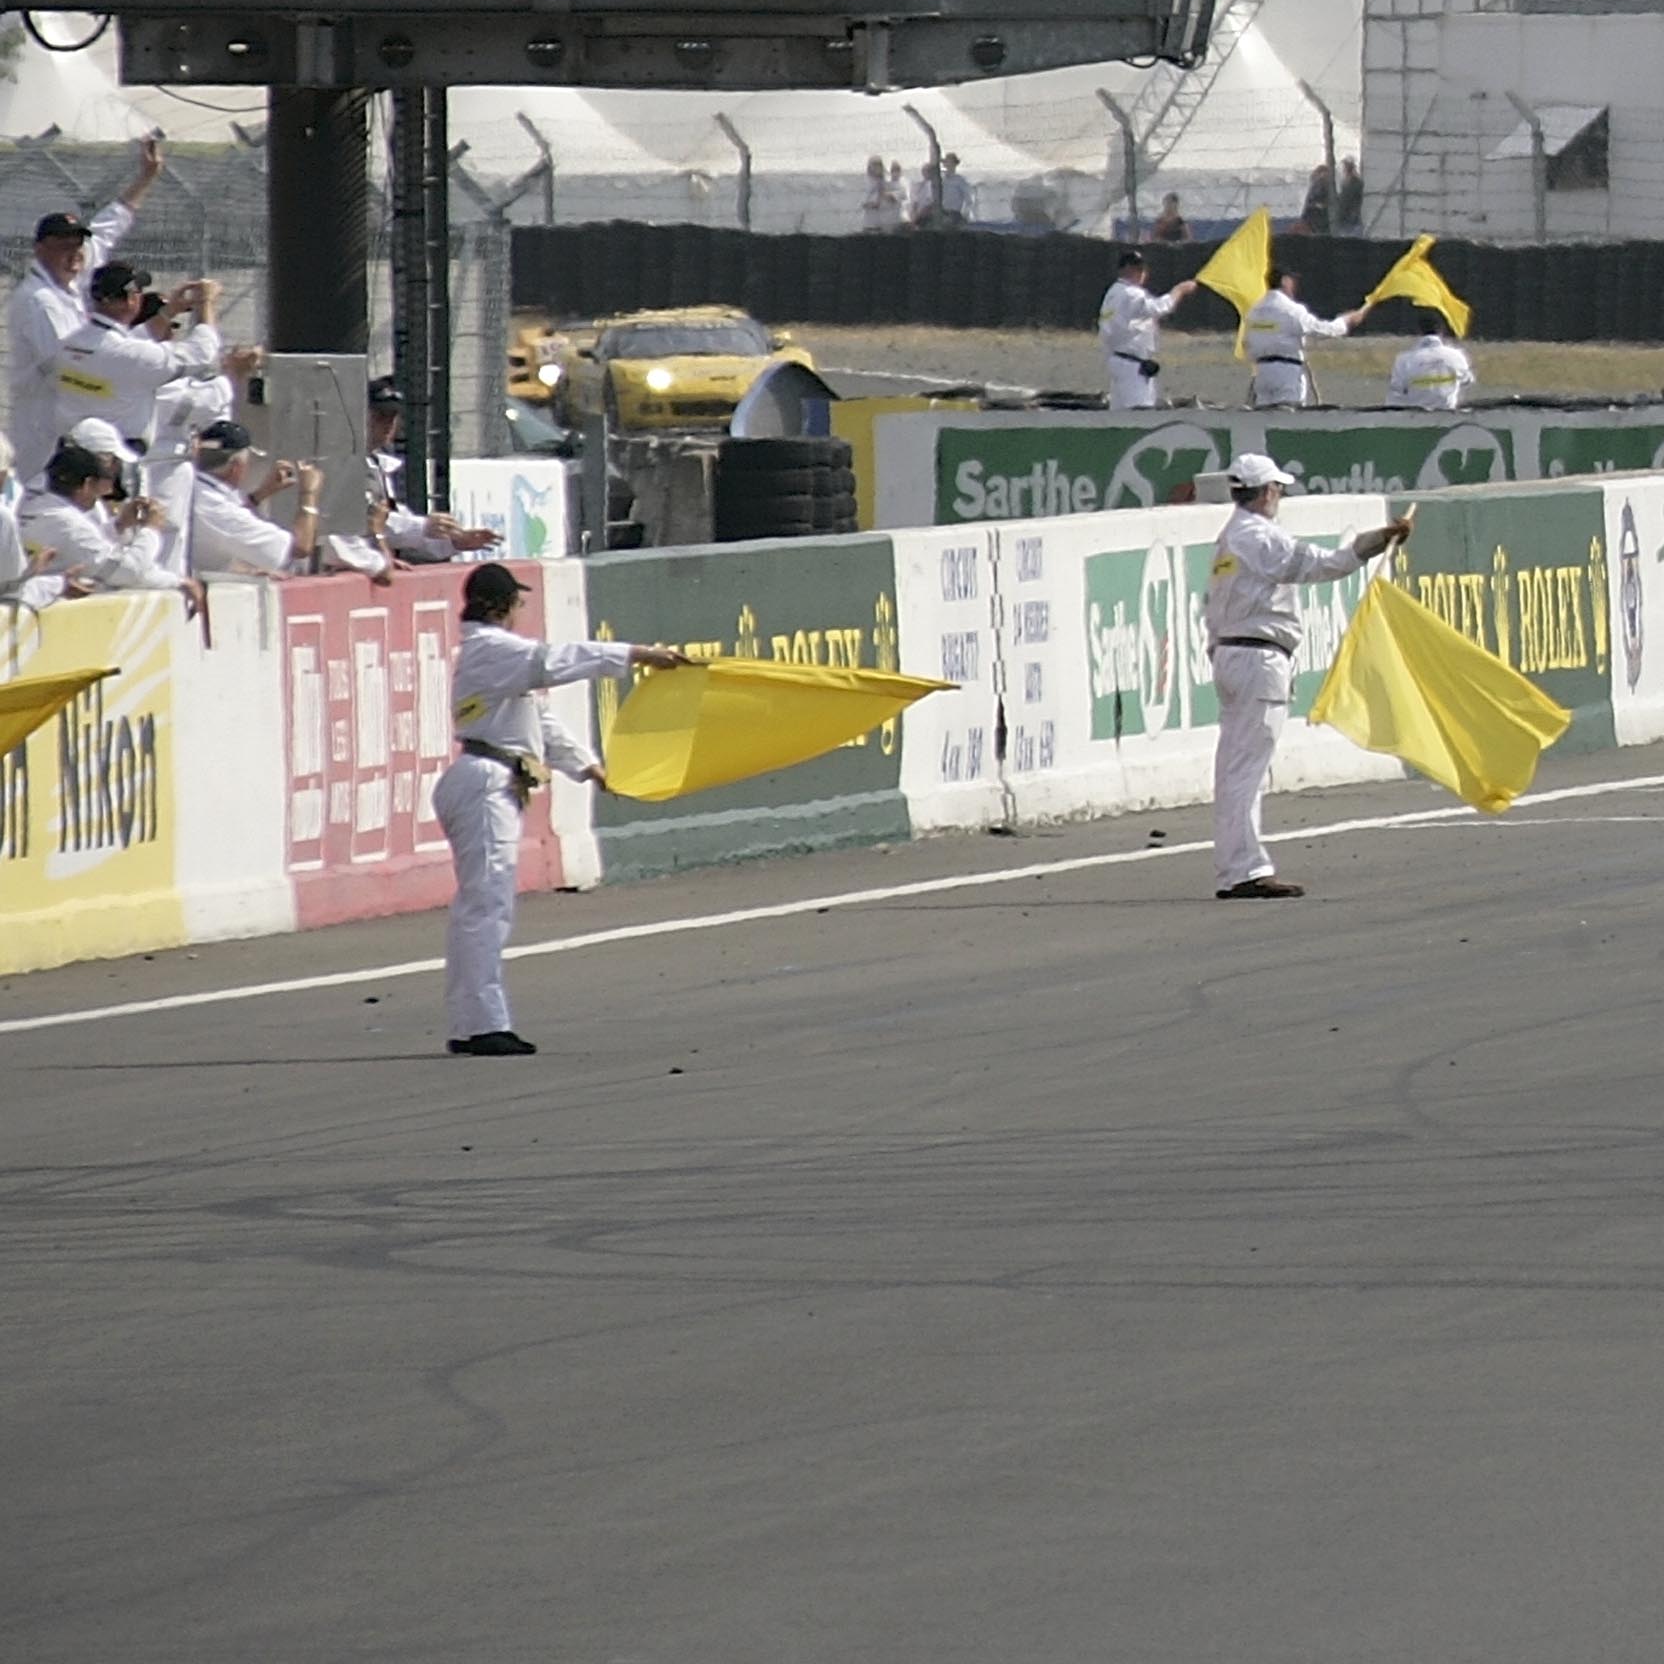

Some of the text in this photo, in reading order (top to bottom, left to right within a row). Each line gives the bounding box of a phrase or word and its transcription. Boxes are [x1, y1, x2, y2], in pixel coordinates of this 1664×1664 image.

[953, 459, 1097, 519] Sarthe
[1090, 601, 1139, 699] Sarthe
[1517, 565, 1587, 674] ROLEX
[58, 678, 156, 853] Nikon
